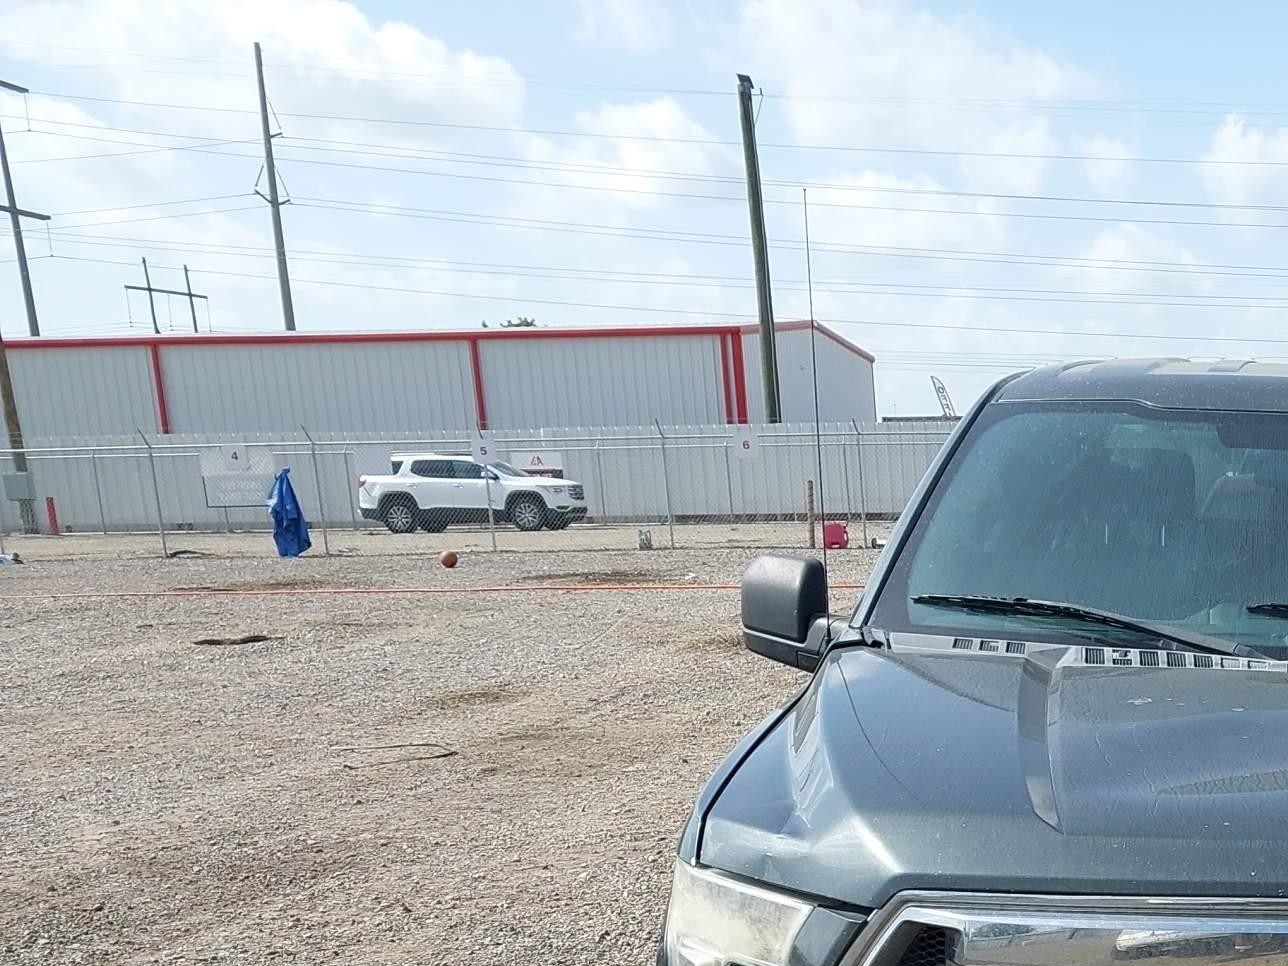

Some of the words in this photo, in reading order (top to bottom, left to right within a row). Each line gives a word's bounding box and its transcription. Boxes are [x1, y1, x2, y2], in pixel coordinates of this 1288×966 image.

[742, 440, 750, 450] 6
[230, 451, 239, 461] 4
[479, 446, 488, 456] 5
